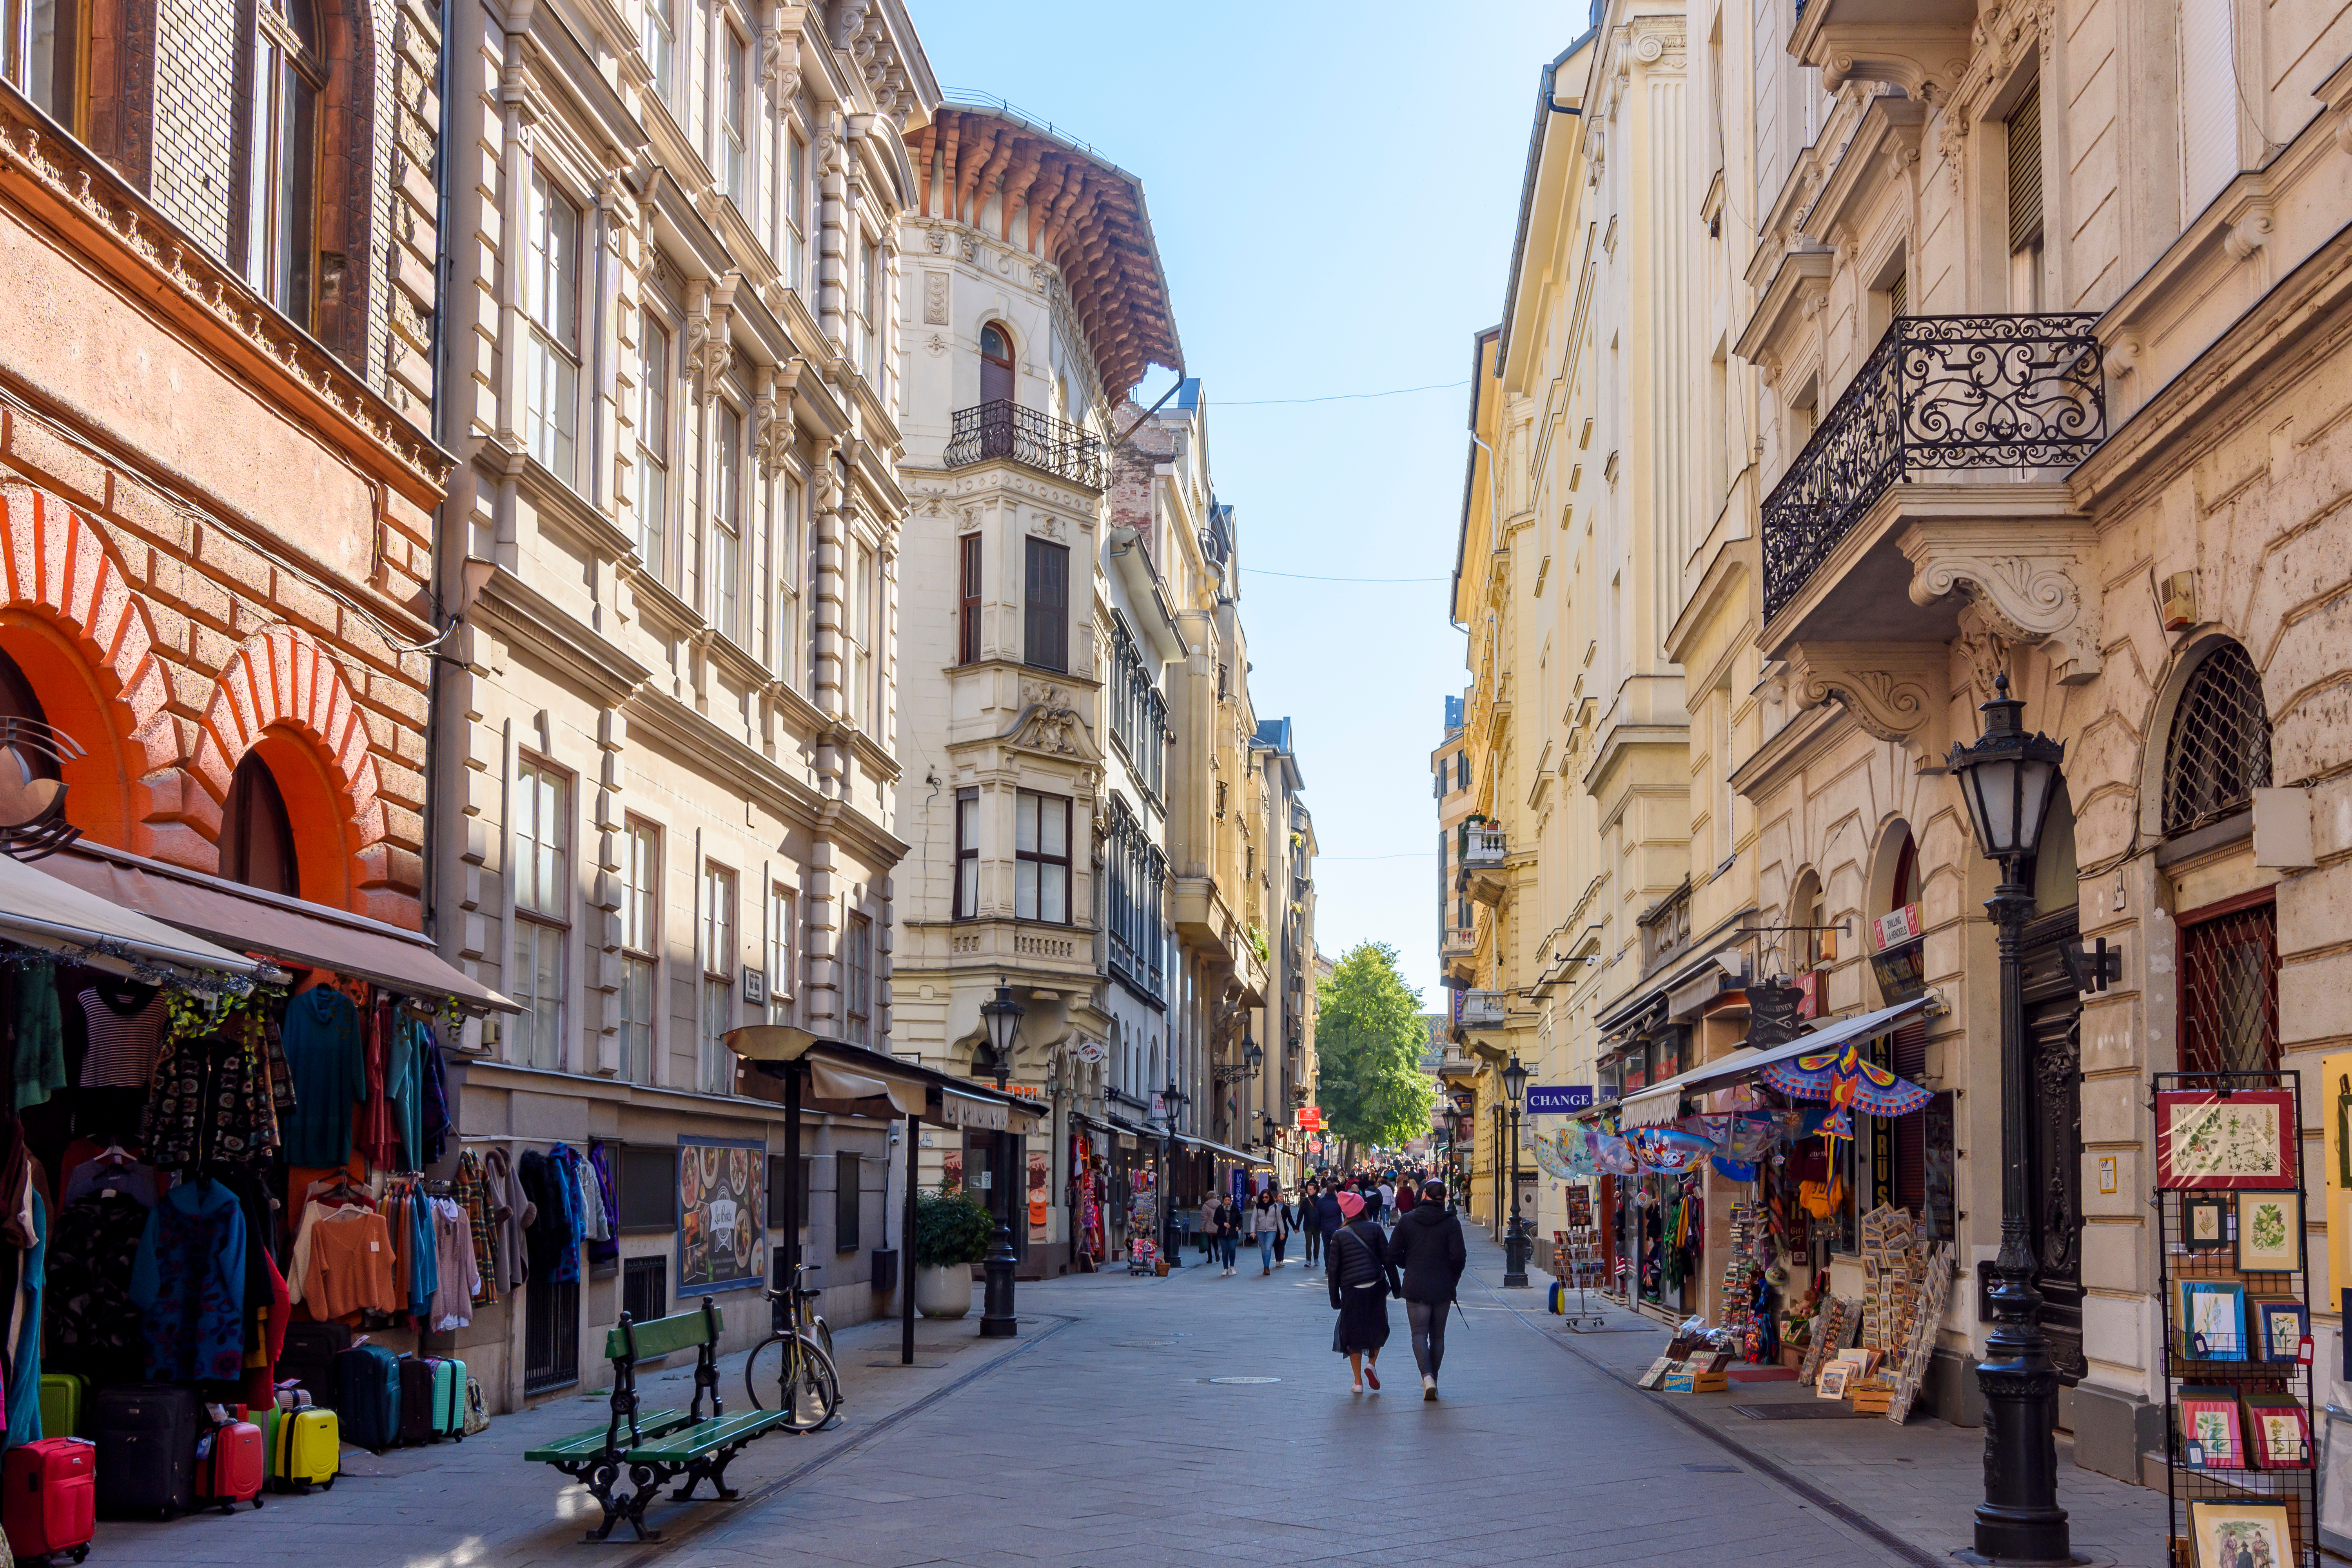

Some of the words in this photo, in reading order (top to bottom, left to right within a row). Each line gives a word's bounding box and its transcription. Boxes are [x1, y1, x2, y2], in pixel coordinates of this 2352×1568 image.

[1887, 916, 1901, 929] ZWILLING
[1756, 1002, 1794, 1013] FLASCHNER
[1530, 1095, 1590, 1106] CHANGE
[1666, 1376, 1693, 1387] BUDAPEST
